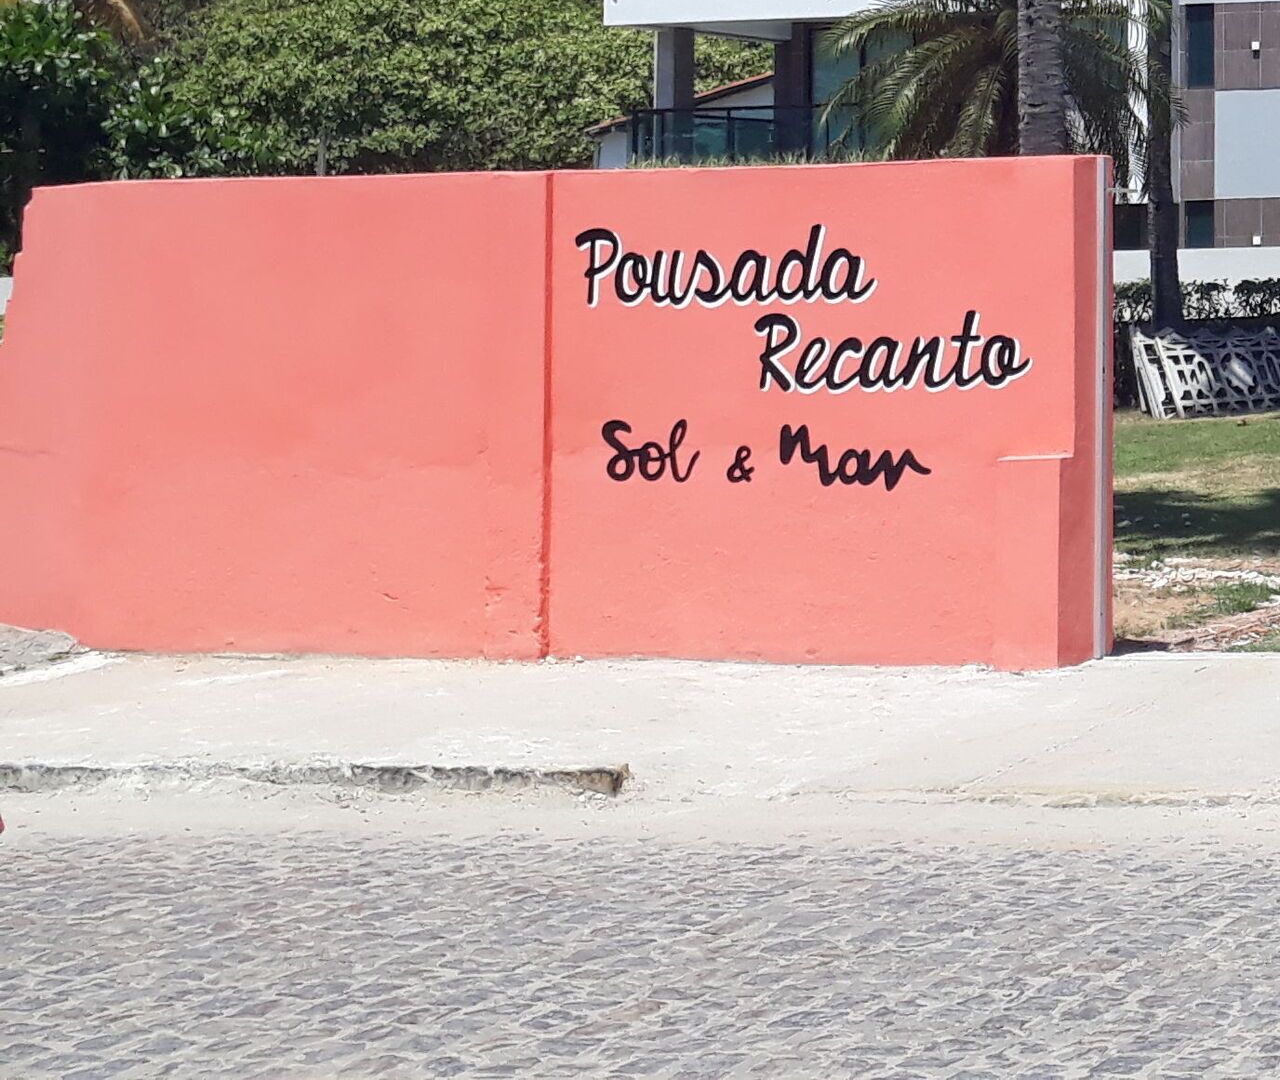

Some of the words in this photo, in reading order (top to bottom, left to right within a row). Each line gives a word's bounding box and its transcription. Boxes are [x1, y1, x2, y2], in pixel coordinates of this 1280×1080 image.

[575, 224, 878, 309] Pousada
[754, 311, 1033, 394] Recanto
[601, 419, 700, 483] Sol
[726, 445, 754, 483] &
